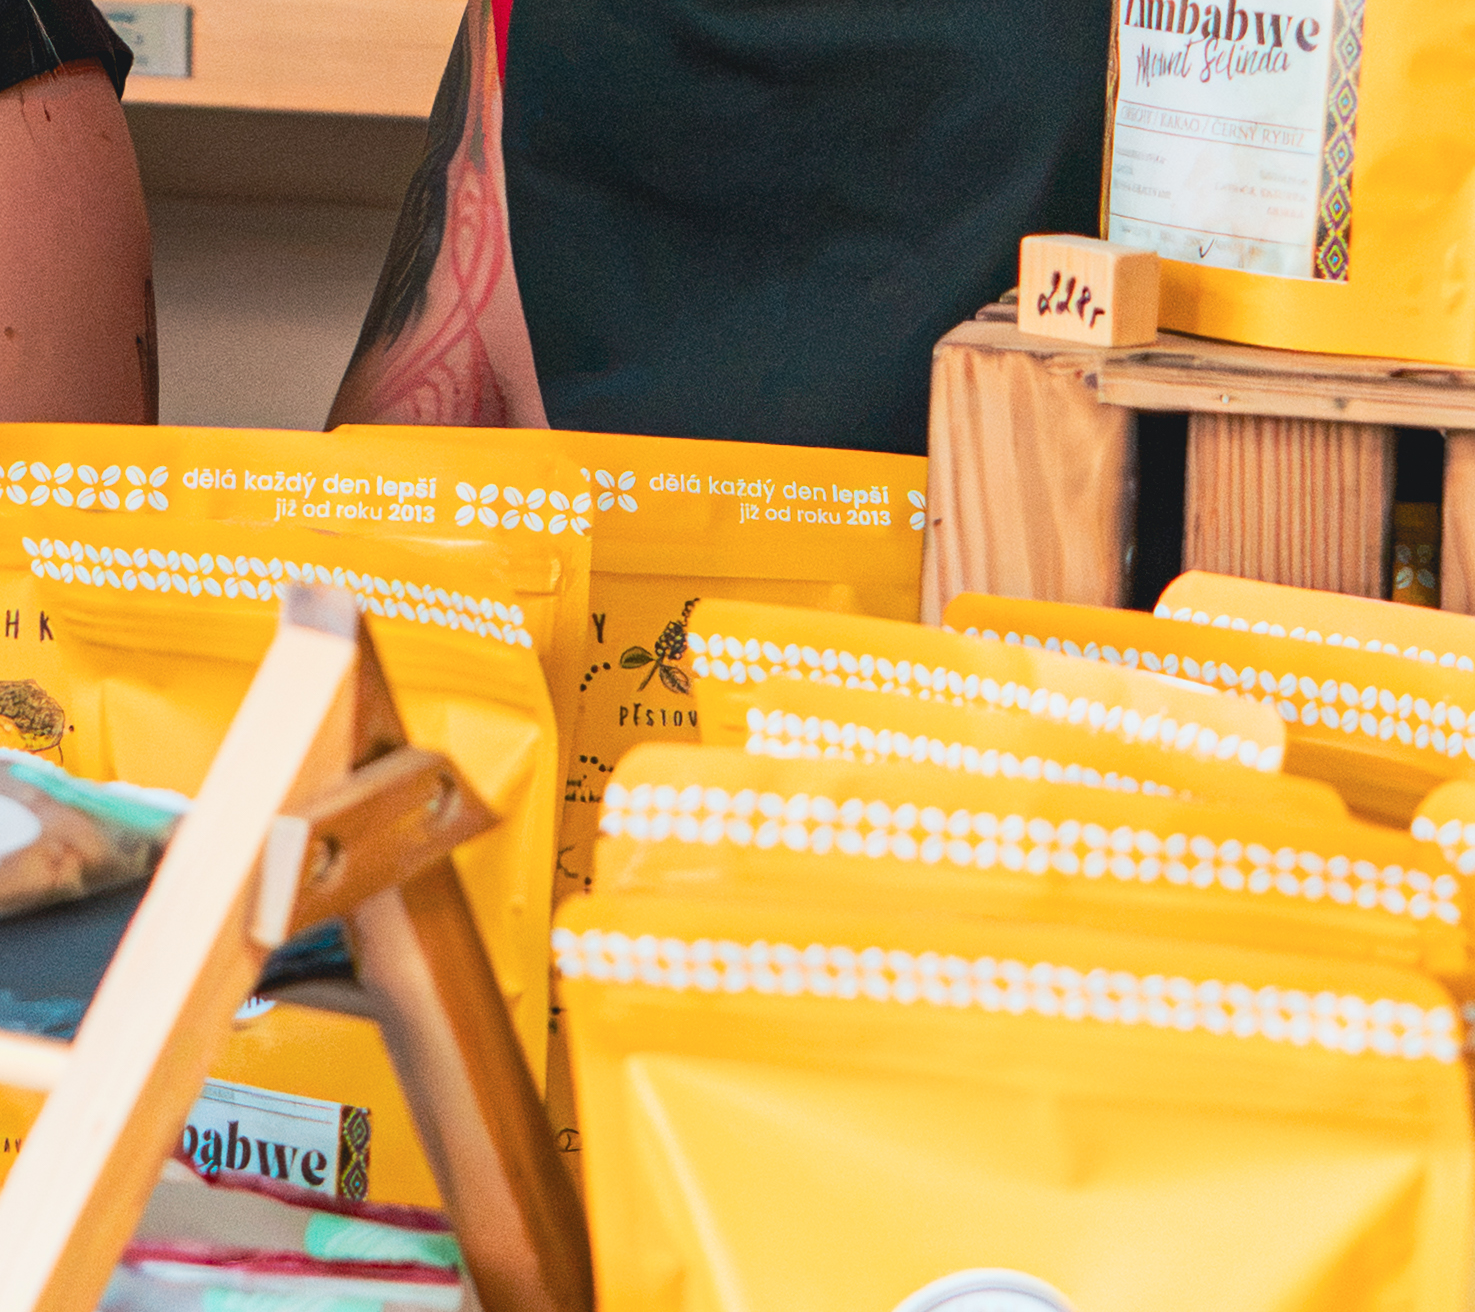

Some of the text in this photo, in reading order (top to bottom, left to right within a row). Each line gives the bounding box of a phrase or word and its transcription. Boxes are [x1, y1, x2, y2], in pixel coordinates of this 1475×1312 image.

[1199, 36, 1291, 83] Selinda
[181, 466, 438, 507] dělá každý den lepší
[648, 473, 890, 506] dělá každý den lepší
[274, 495, 436, 525] již od roku 2013
[738, 503, 892, 527] již od roku 2013
